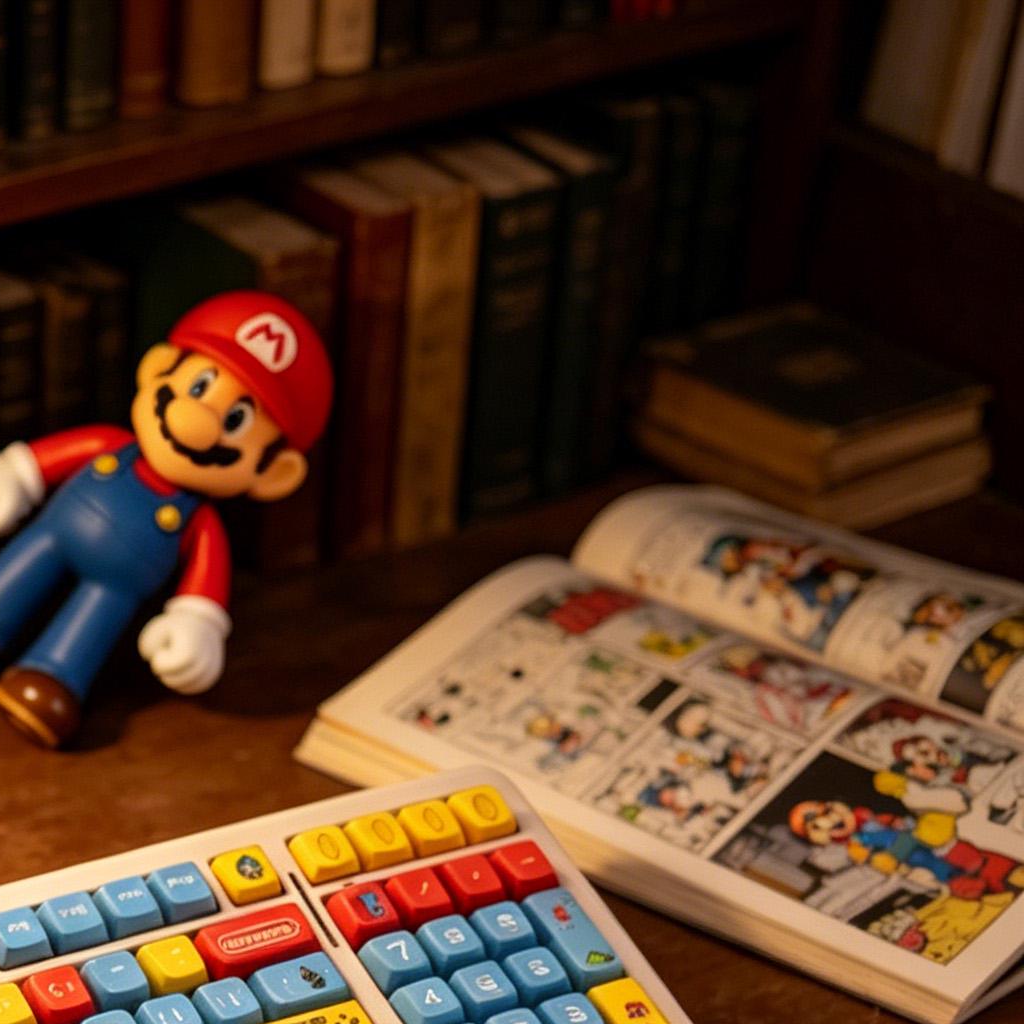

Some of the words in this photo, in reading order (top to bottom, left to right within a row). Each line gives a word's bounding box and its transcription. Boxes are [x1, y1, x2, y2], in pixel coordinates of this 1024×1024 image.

[245, 324, 285, 364] M
[386, 939, 409, 961] 7
[425, 989, 442, 1004] 4
[565, 1006, 588, 1024] 3
